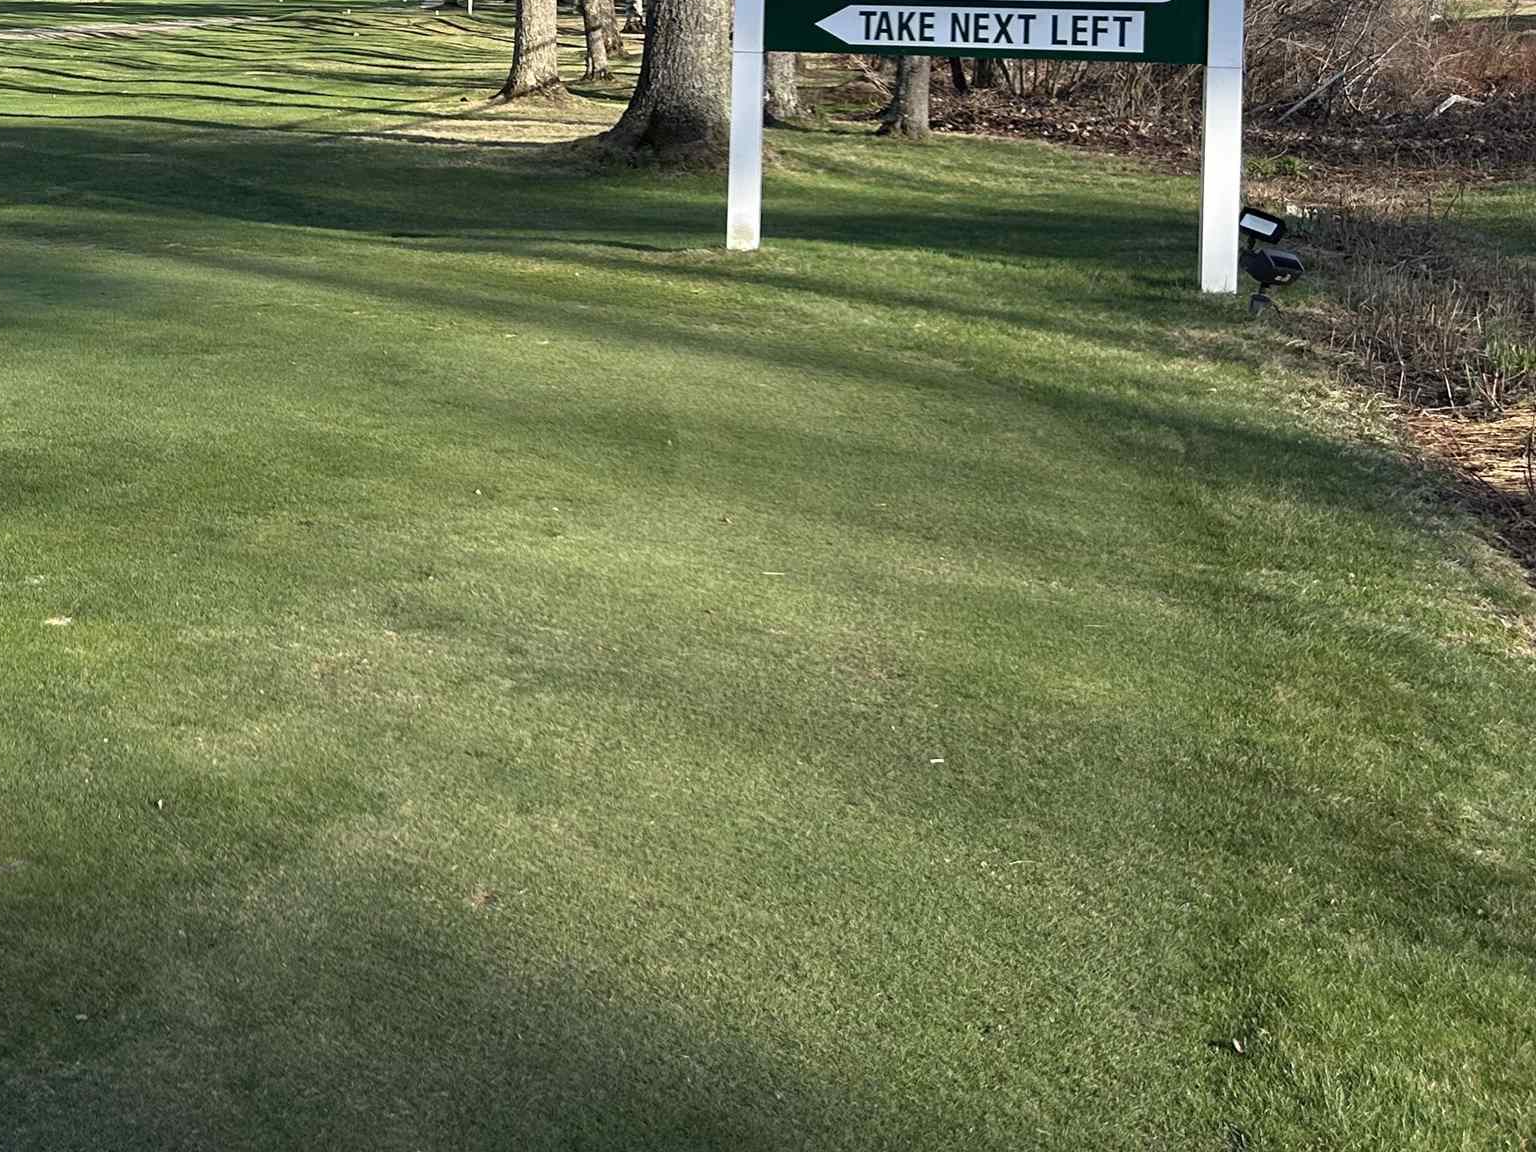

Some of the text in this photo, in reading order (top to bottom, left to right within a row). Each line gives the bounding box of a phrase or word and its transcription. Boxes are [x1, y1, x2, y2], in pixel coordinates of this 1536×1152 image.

[859, 11, 1132, 47] TAKE NEXT LEFT
